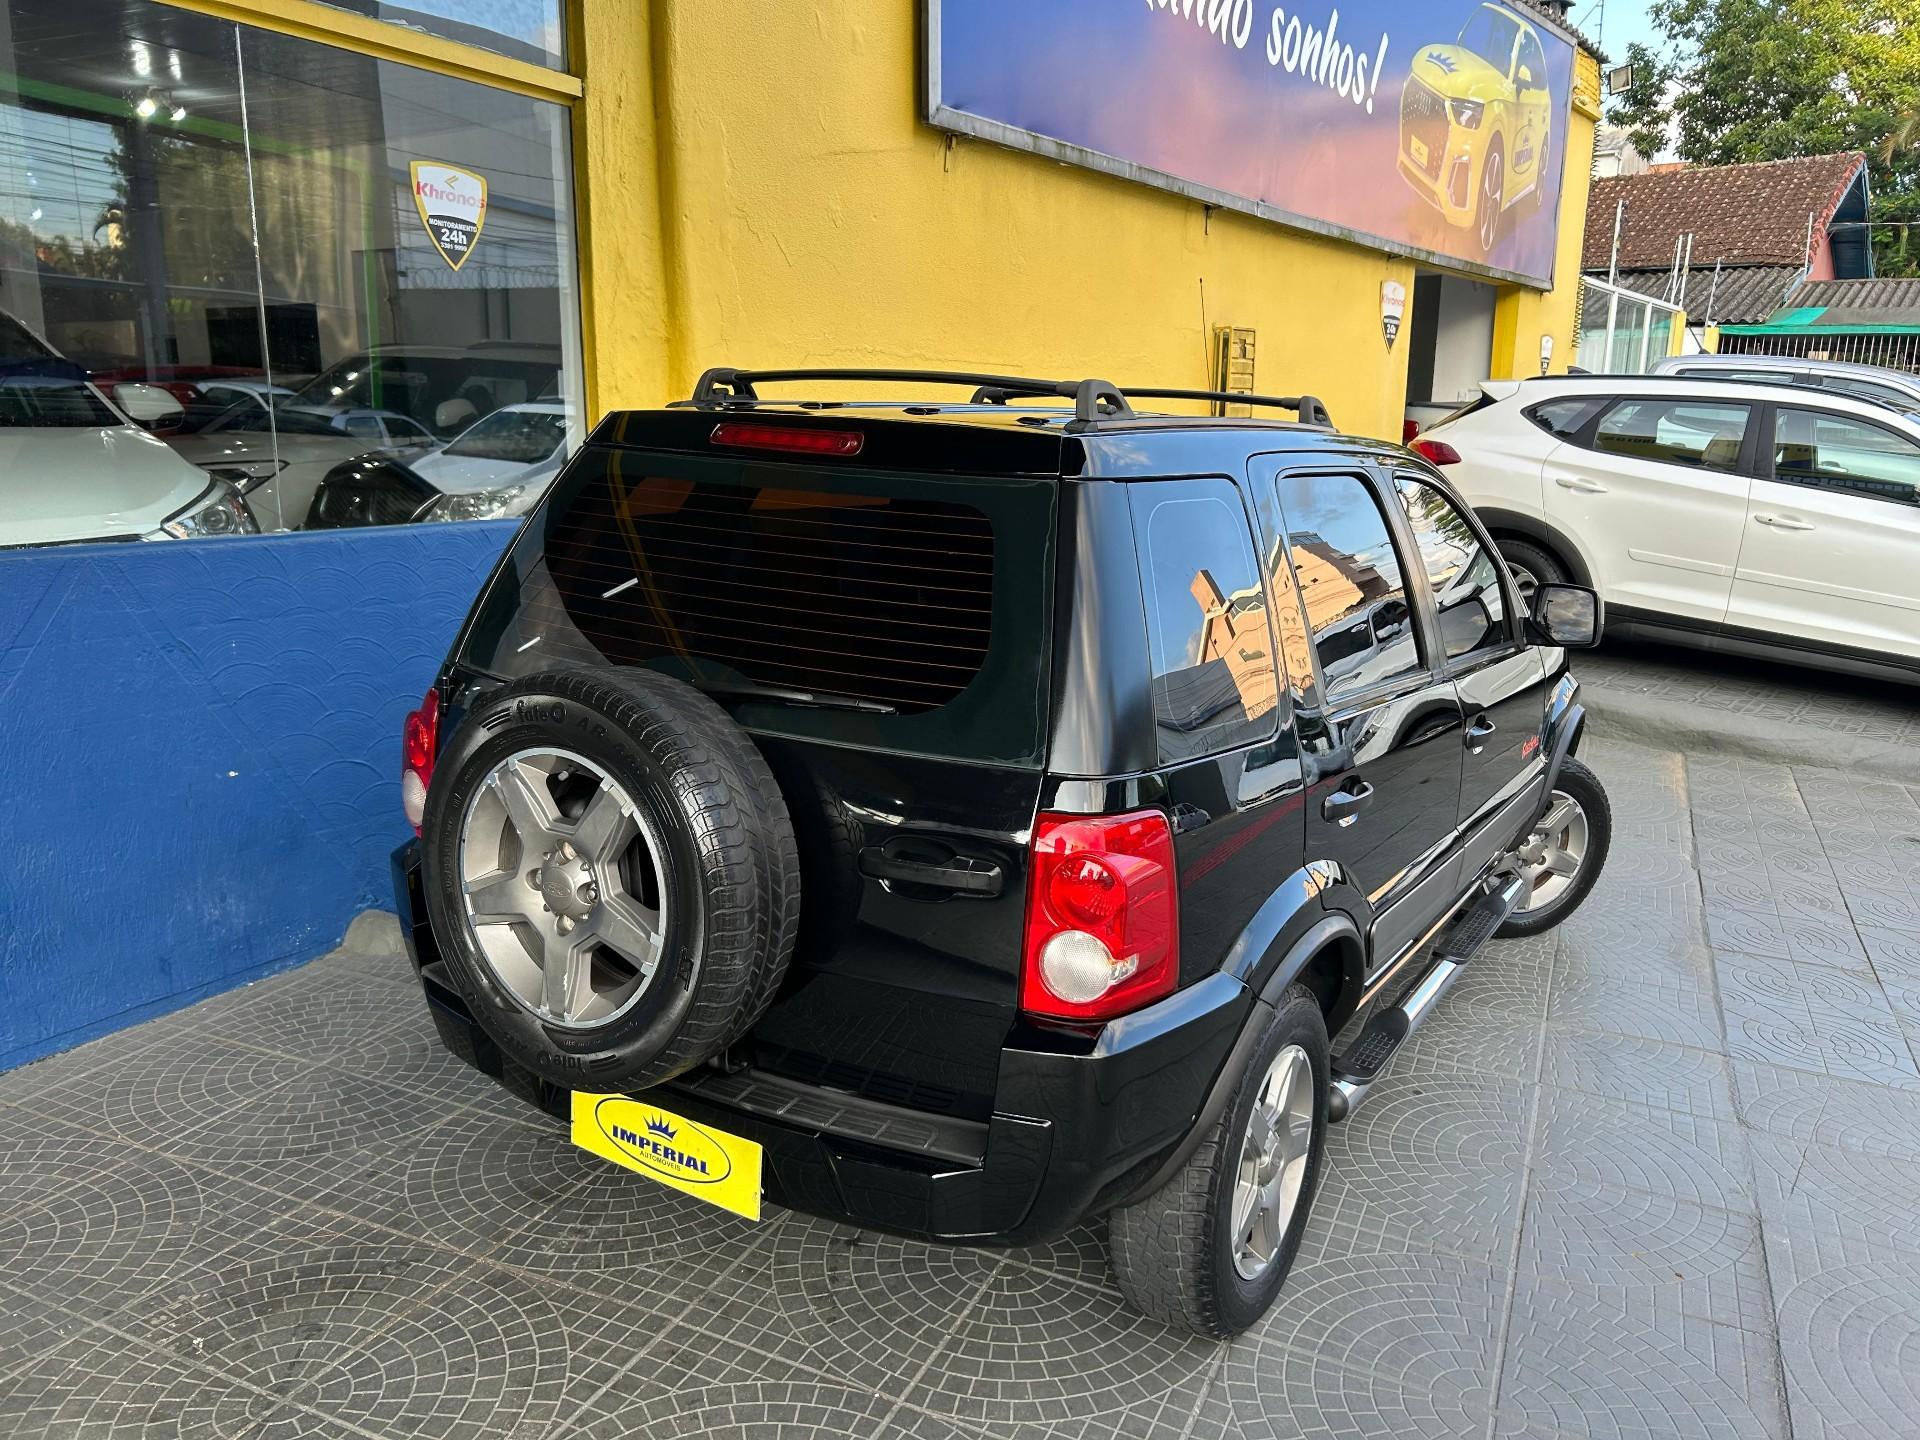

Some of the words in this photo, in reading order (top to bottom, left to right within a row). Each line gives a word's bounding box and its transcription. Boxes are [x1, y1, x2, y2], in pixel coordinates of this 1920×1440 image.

[1266, 7, 1389, 115] sonhos!
[416, 181, 486, 208] Khronos
[428, 218, 478, 233] MONITORAMENTO
[441, 228, 467, 245] 24h
[613, 1125, 711, 1176] IMPERIAL
